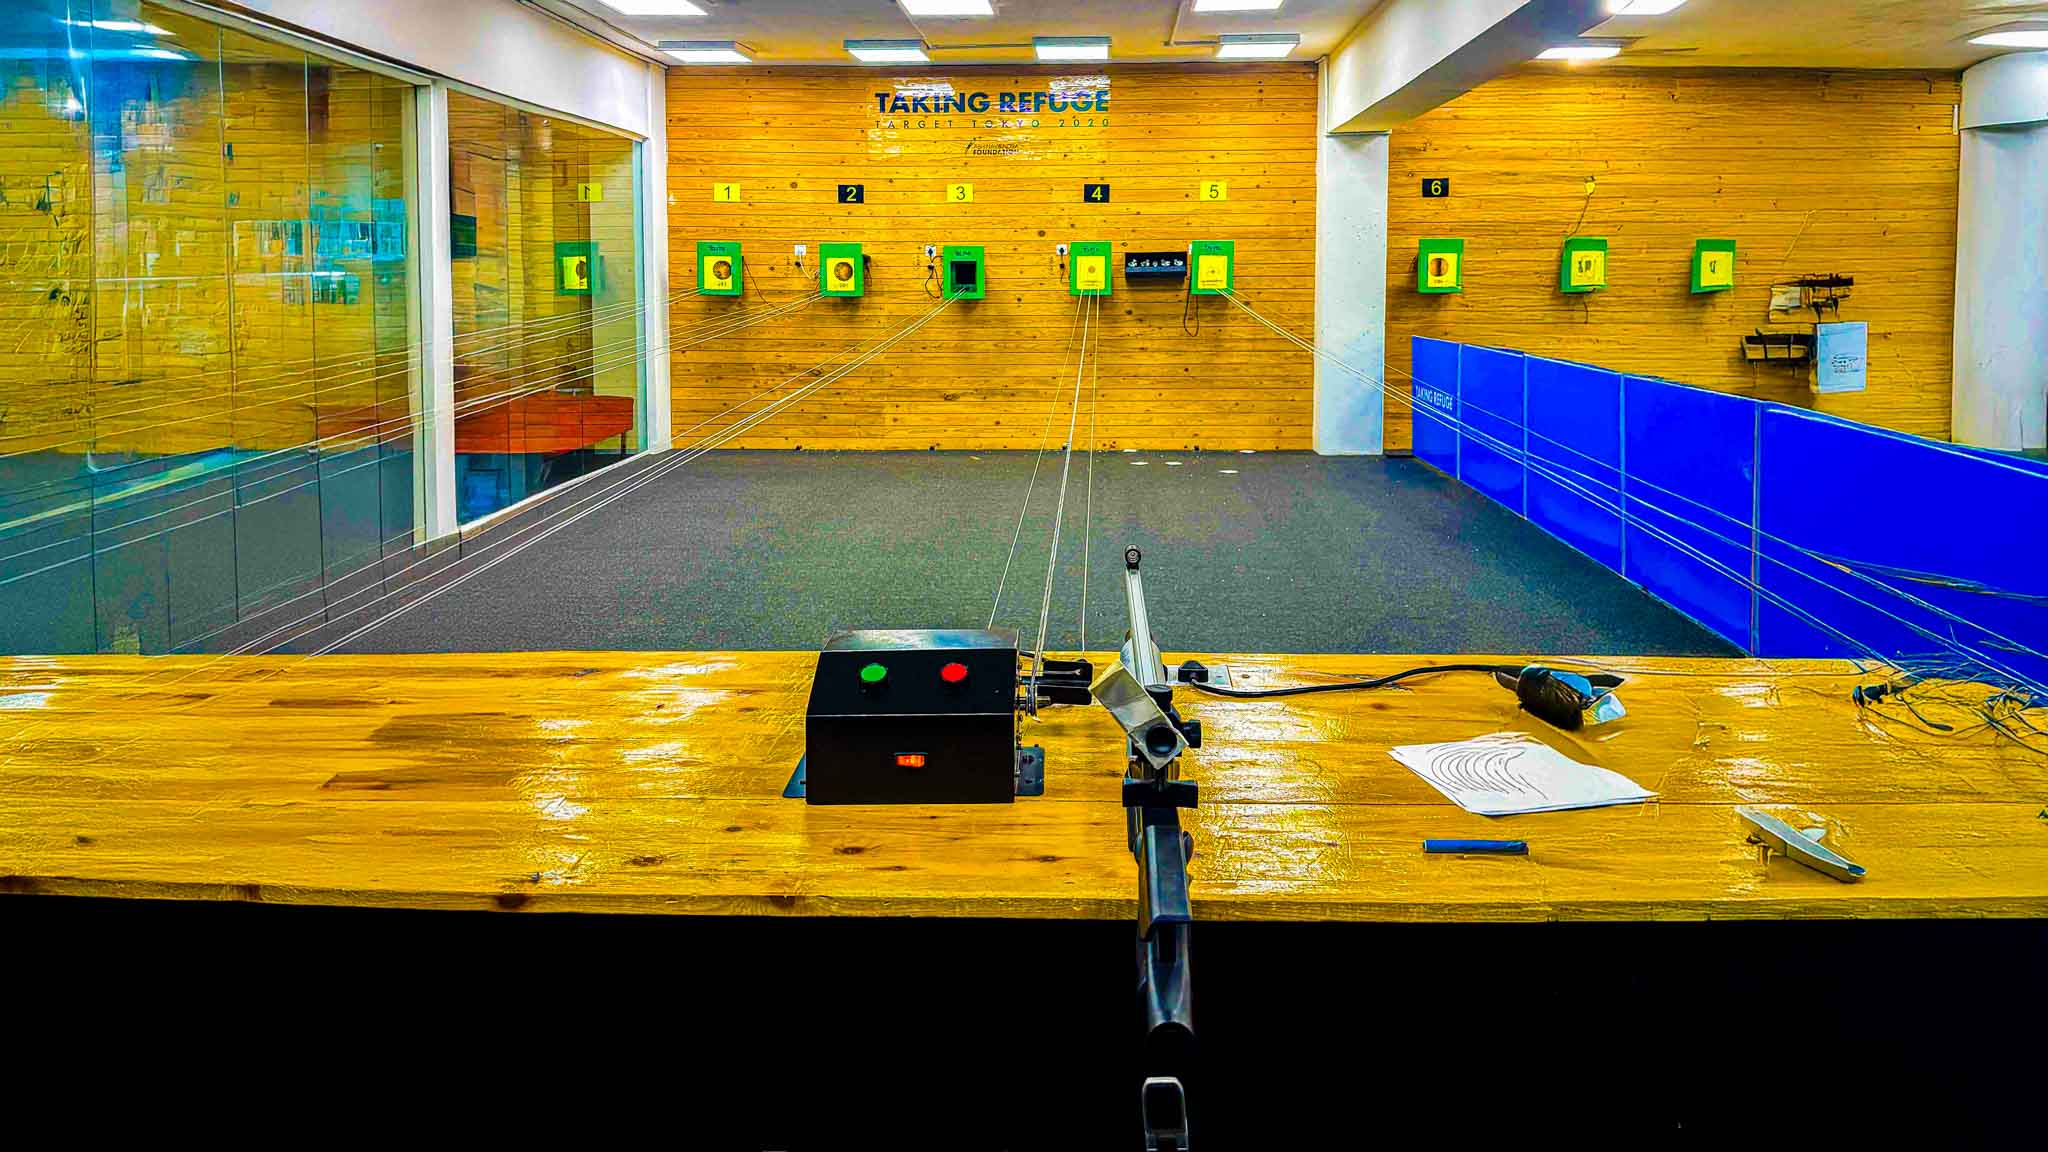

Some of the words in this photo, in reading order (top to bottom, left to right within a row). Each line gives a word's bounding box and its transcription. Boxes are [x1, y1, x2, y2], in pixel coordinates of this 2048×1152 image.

[874, 92, 991, 113] TAKING
[999, 90, 1109, 112] REFUGE
[875, 120, 952, 128] TARGET
[972, 119, 1040, 128] TOKYO
[1059, 119, 1108, 127] 2020
[724, 185, 730, 200] 1
[846, 186, 856, 201] 2
[956, 186, 965, 200] 3
[1091, 186, 1102, 200] 4
[1209, 185, 1218, 198] 5
[1431, 180, 1441, 195] 6
[1433, 391, 1453, 410] REFUGE
